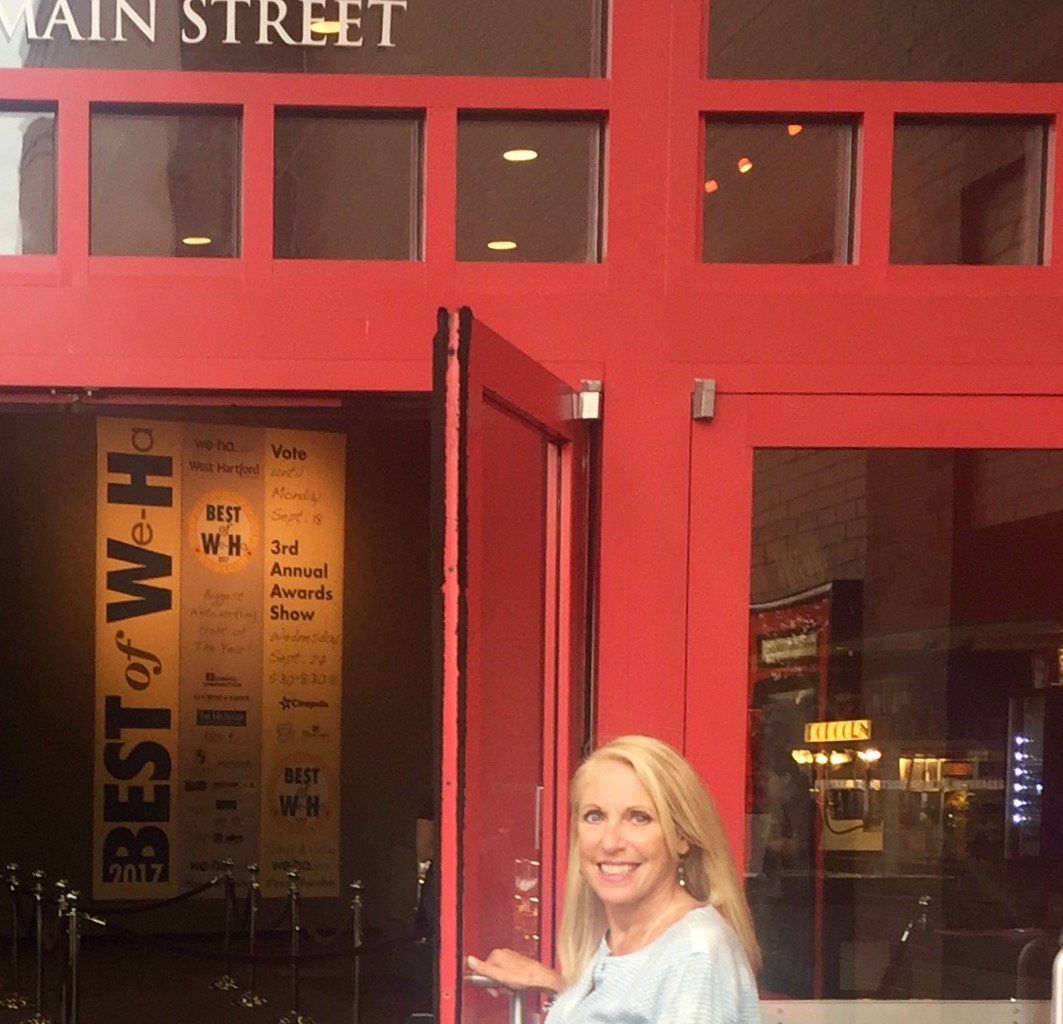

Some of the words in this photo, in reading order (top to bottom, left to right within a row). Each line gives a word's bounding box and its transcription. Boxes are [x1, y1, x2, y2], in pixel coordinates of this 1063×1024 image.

[181, 0, 408, 47] STREET
[270, 443, 307, 461] Vote
[188, 460, 213, 473] West
[216, 462, 260, 478] Hartford
[271, 486, 322, 506] Monday
[205, 504, 241, 523] BEST
[106, 427, 174, 624] We-Ha
[218, 522, 233, 537] of
[270, 539, 299, 556] 3rd
[269, 562, 329, 579] Annual
[269, 584, 334, 601] Awards
[269, 605, 315, 621] Show
[115, 630, 163, 691] of
[284, 767, 320, 785] BEST
[101, 695, 172, 883] BEST
[109, 863, 164, 883] 2017
